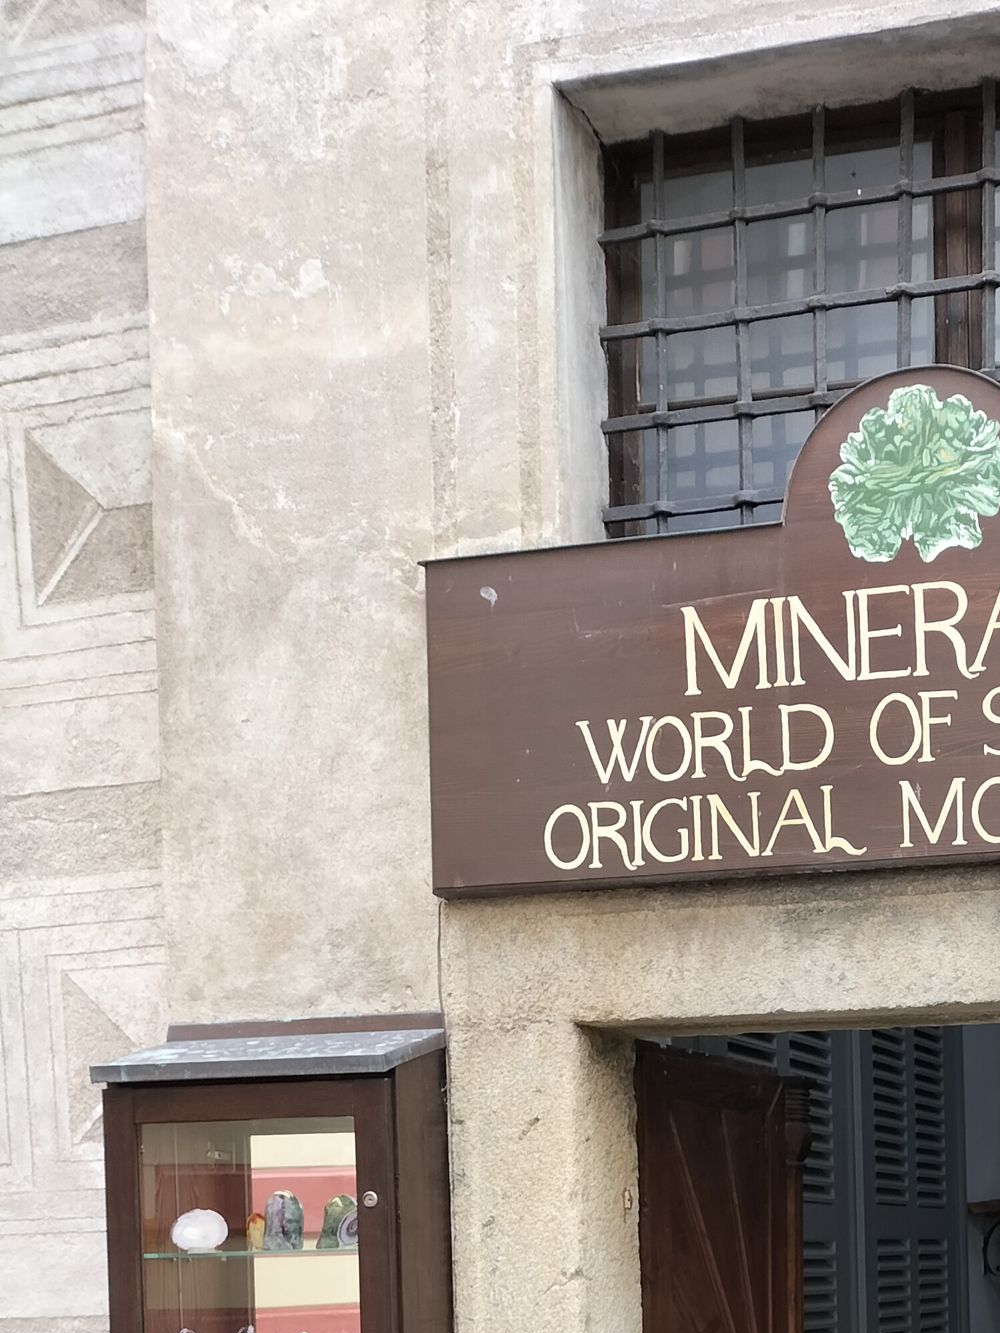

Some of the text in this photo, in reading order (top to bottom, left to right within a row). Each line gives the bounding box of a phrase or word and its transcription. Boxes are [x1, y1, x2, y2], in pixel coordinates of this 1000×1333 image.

[575, 703, 835, 785] WORLD
[870, 690, 959, 766] OF
[543, 785, 868, 870] ORIGINAL
